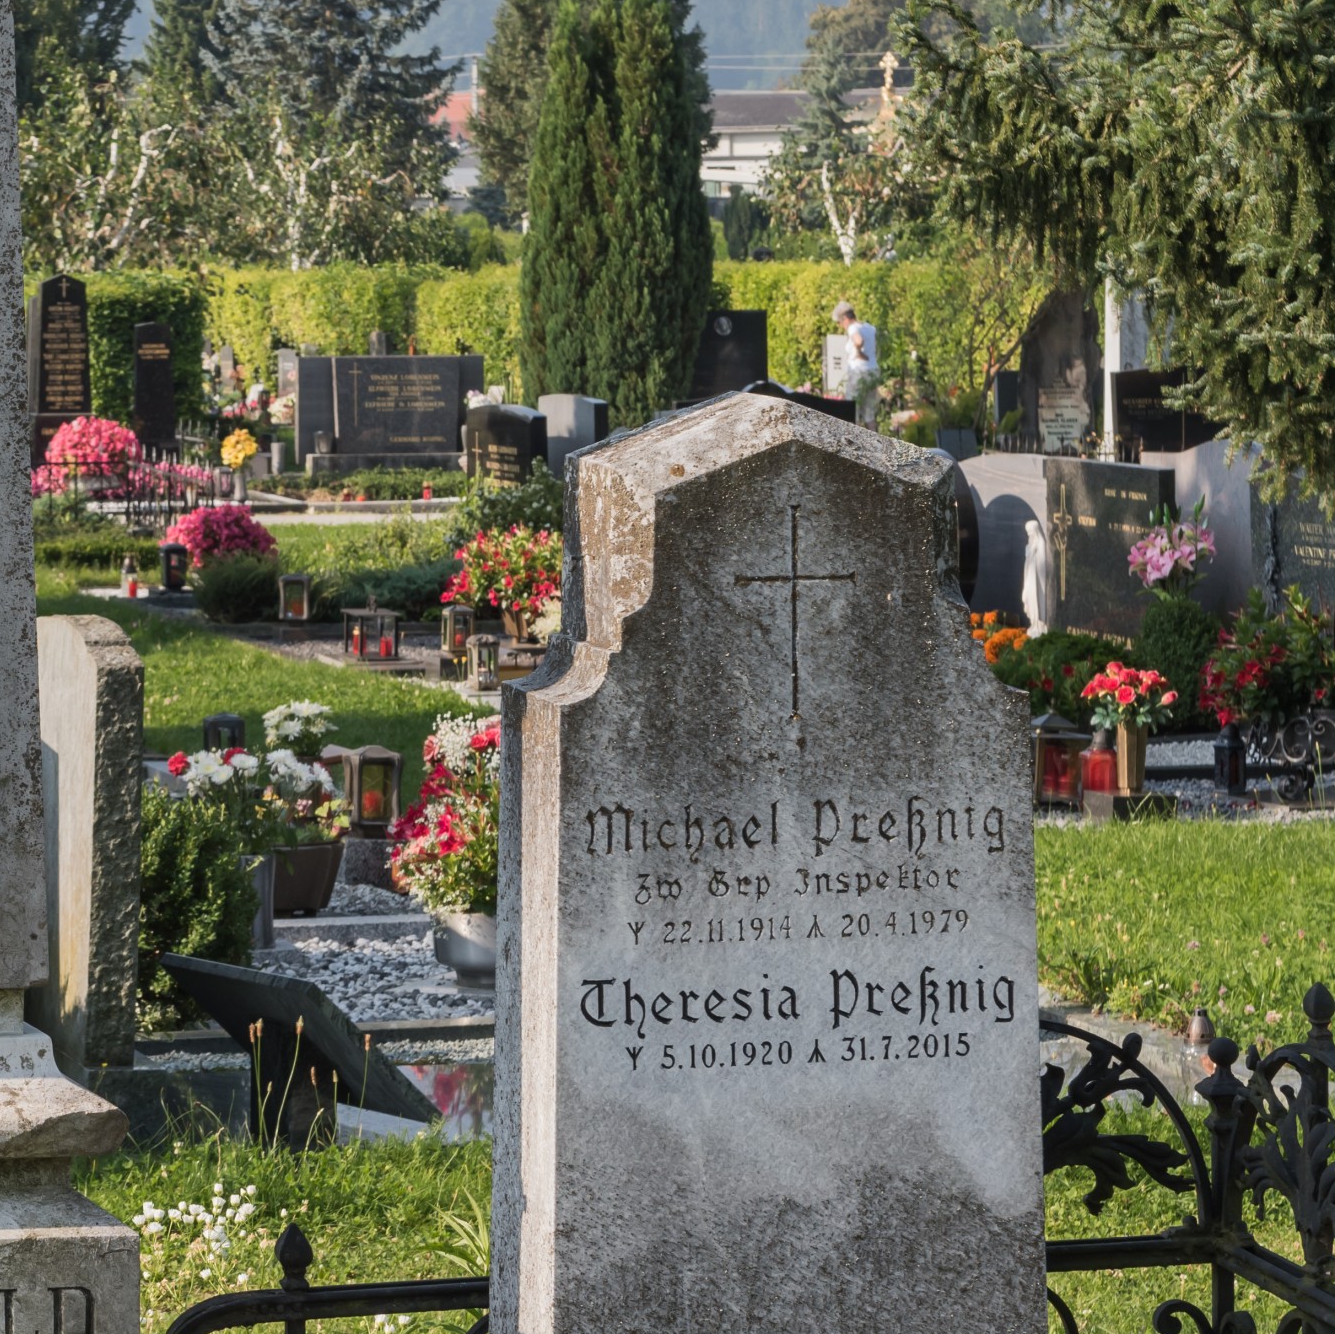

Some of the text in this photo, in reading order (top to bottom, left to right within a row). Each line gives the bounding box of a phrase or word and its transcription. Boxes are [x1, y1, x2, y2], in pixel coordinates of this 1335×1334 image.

[585, 795, 1005, 864] Michael Preßnig
[663, 908, 969, 945] 22.11.1914 20.4.1979
[580, 964, 1015, 1039] Theresia Preßnig
[661, 1032, 971, 1070] 5.10.1920 31.7.2015
